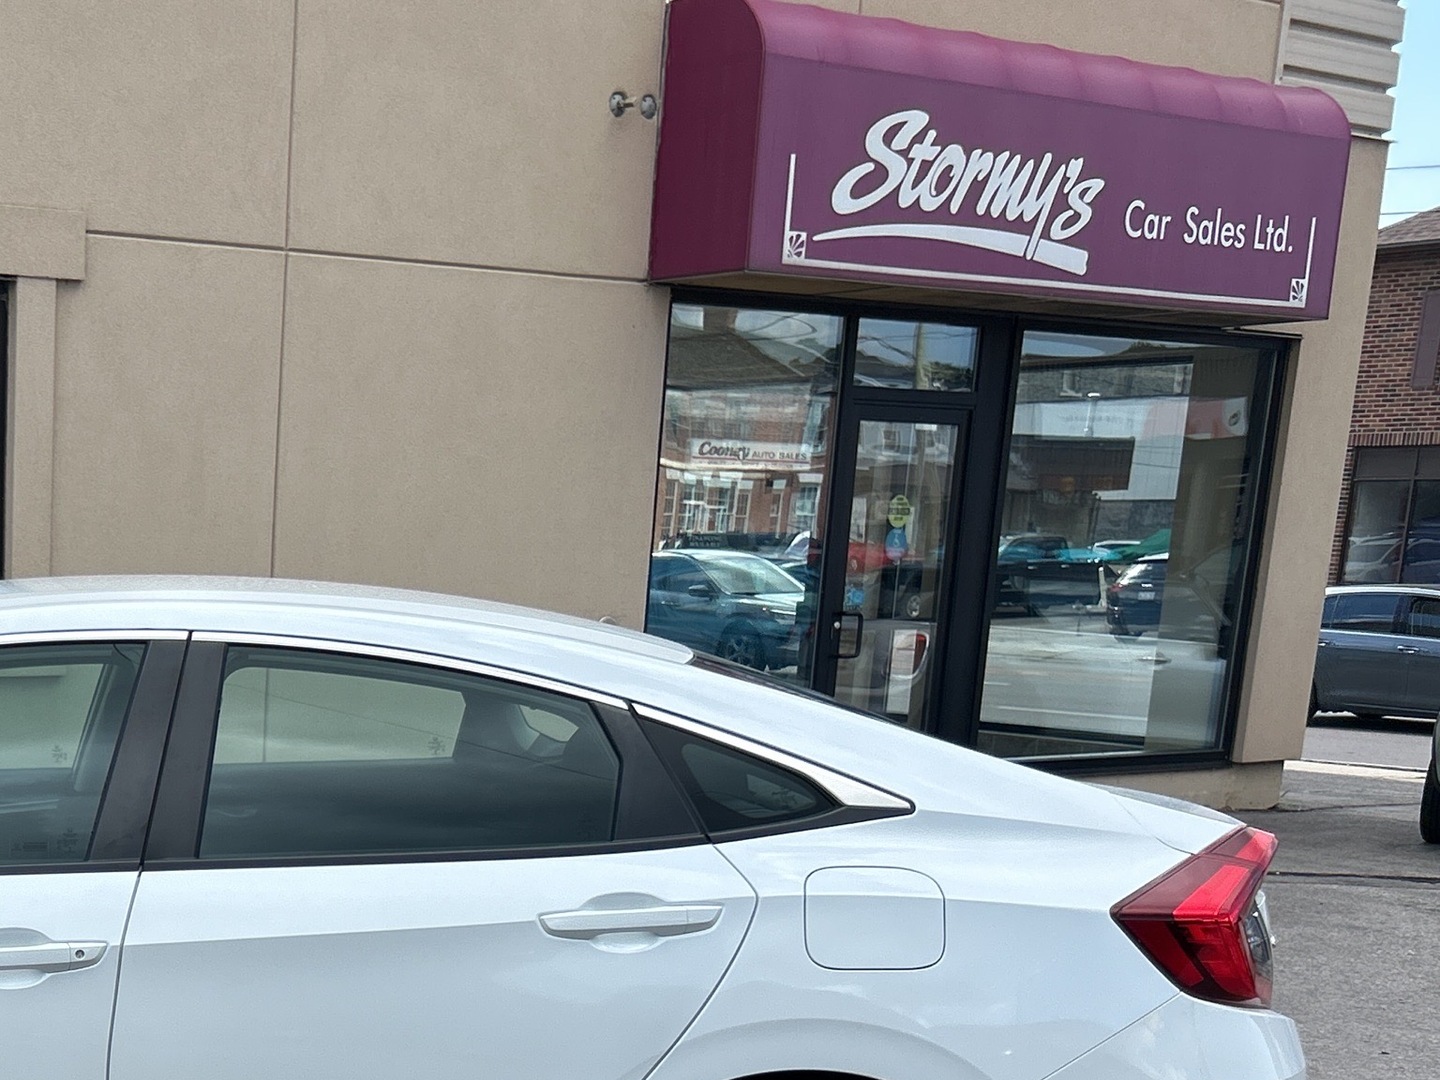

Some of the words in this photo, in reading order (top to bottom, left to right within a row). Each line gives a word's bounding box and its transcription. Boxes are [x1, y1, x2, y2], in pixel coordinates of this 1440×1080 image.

[831, 109, 1105, 260] Stormy's
[1124, 199, 1172, 240] Car
[1183, 206, 1246, 249] Sales
[1253, 214, 1293, 253] Ltd.
[751, 450, 776, 459] AUTO
[778, 451, 807, 460] SALES
